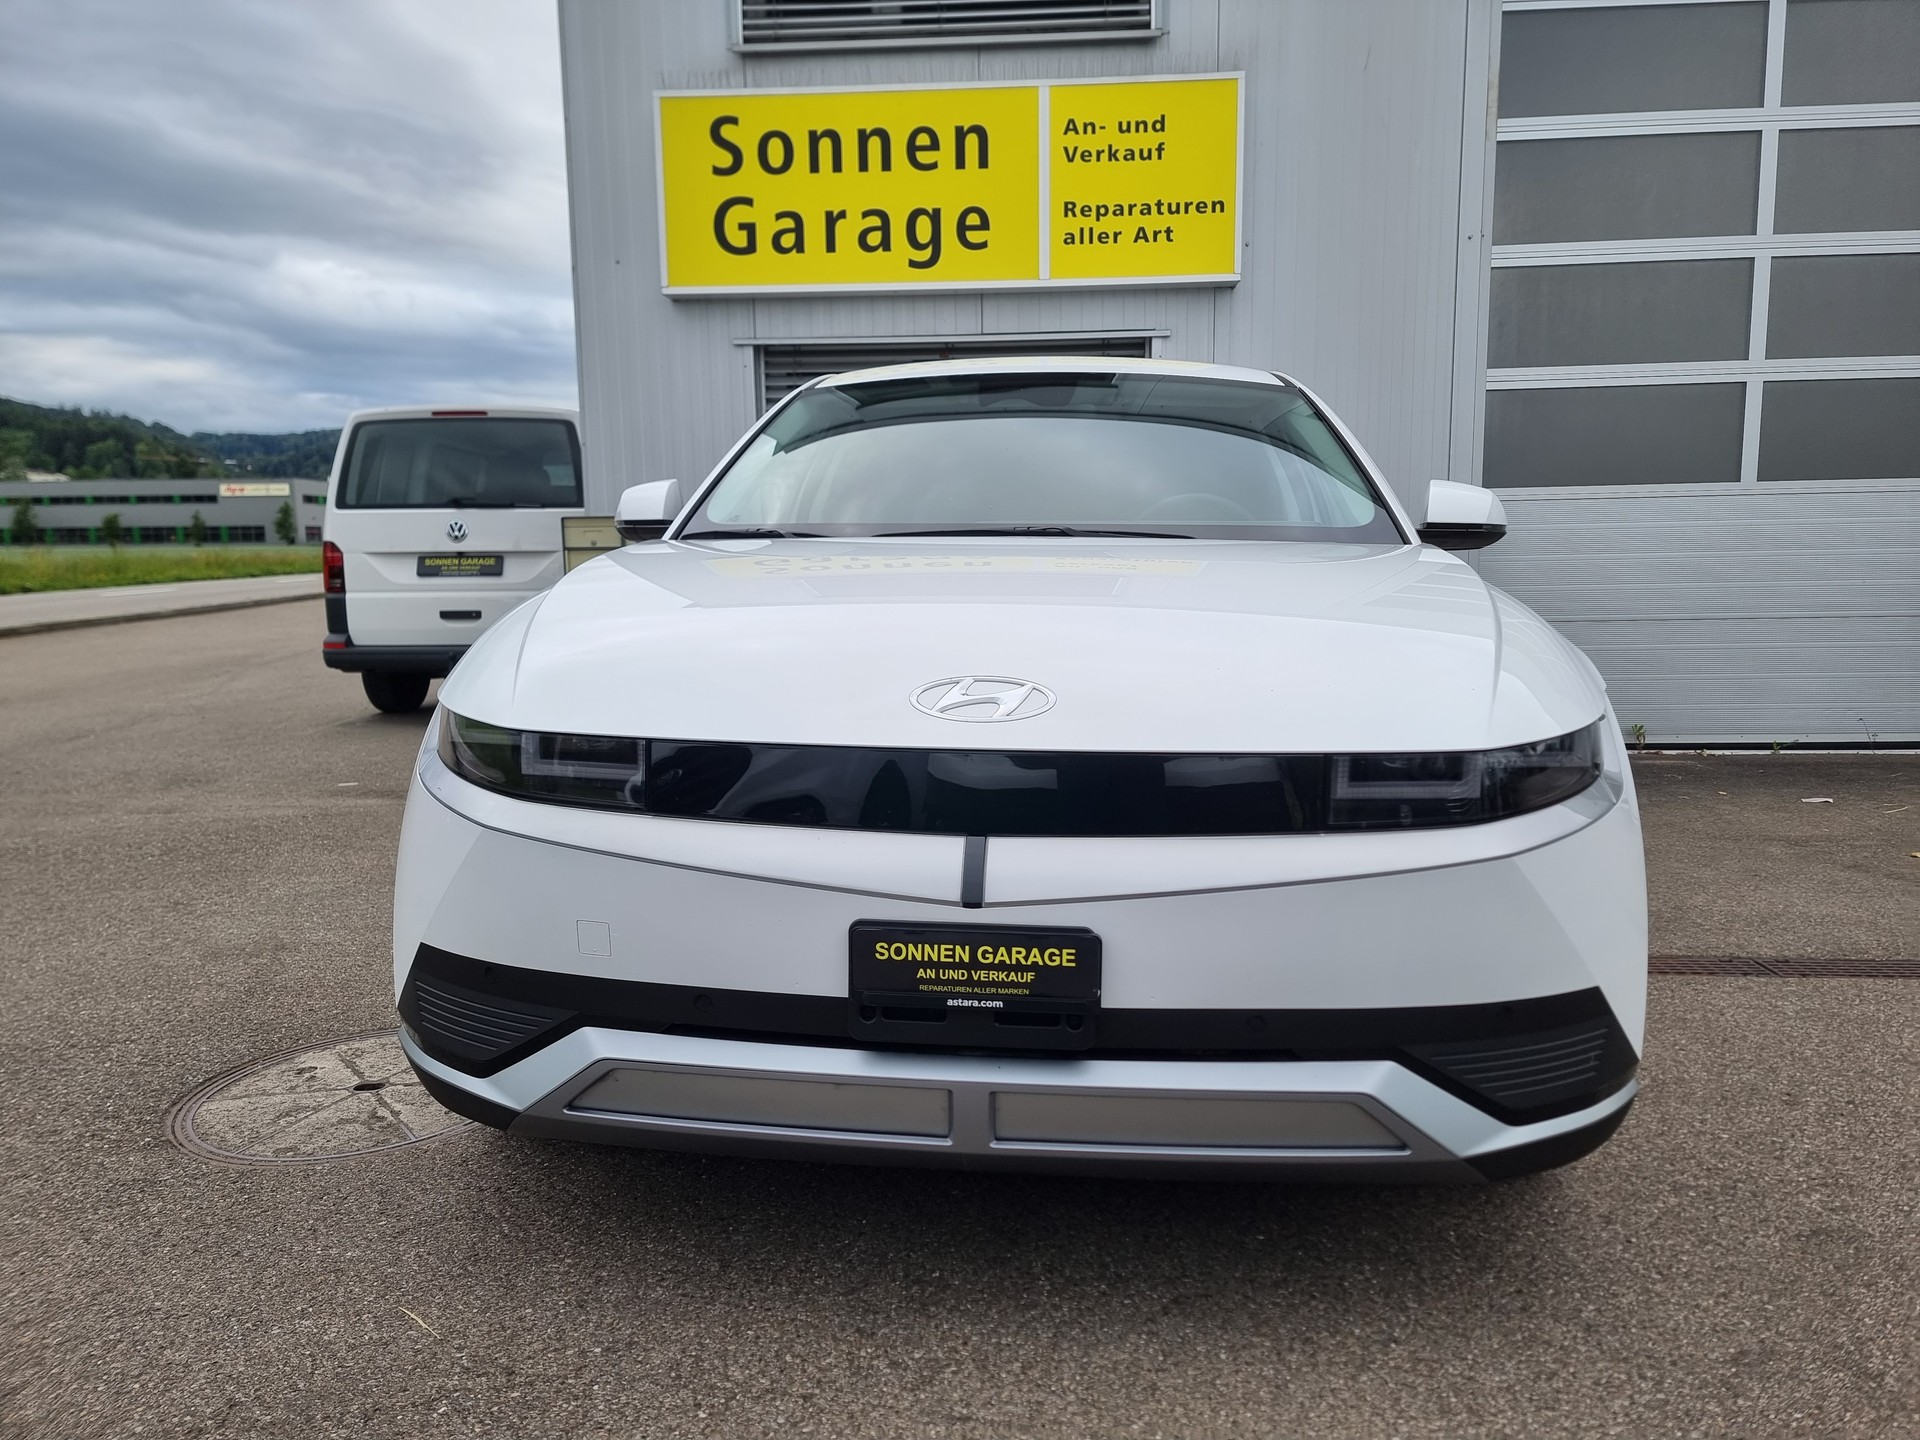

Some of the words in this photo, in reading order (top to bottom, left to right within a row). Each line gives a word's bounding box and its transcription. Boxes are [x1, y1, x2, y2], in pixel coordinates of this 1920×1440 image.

[1063, 118, 1106, 135] An-
[1117, 114, 1166, 134] und
[709, 115, 990, 177] Sonnen
[1063, 142, 1165, 163] Verkauf
[1063, 199, 1225, 222] Reparaturen
[713, 196, 991, 269] Garage
[1063, 226, 1122, 245] aller
[1133, 226, 1174, 244] Art
[425, 557, 459, 566] SONNEN
[460, 557, 496, 566] GARAGE
[875, 942, 970, 963] SONNEN
[977, 945, 1076, 967] GARAGE
[916, 968, 936, 979] AN
[939, 969, 968, 981] UND
[971, 970, 1035, 983] VERKAUF
[919, 984, 972, 993] REPARATUREN
[946, 998, 1004, 1008] astara.com
